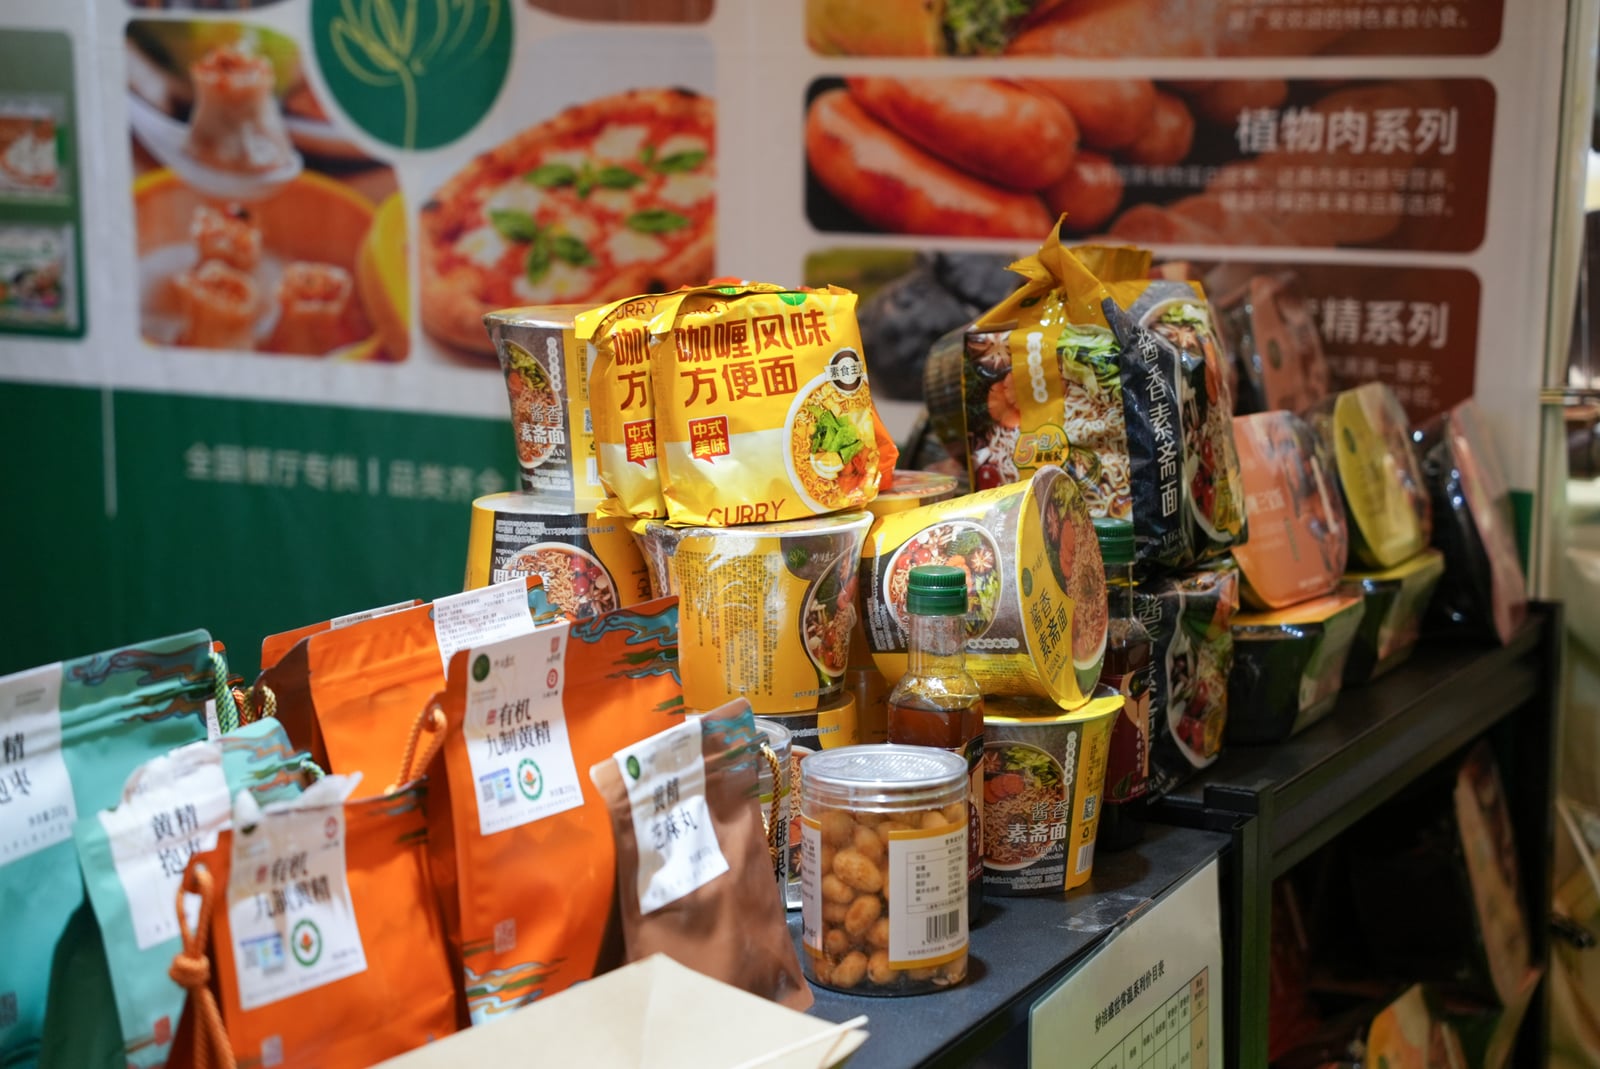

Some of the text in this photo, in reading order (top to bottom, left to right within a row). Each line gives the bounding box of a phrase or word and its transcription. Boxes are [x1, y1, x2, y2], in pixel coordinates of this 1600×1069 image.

[1235, 106, 1459, 155] 植物肉系列
[674, 309, 832, 363] 咖喱风味
[1312, 297, 1450, 348] 精系列
[612, 325, 650, 366] 咖
[684, 355, 799, 408] 方便面
[521, 422, 565, 445] 素斋面
[693, 419, 724, 437] 中式
[1135, 326, 1179, 518] 酱香素斋面
[695, 437, 727, 458] 美味
[707, 498, 786, 524] CURRY
[500, 699, 531, 727] 有机
[487, 720, 551, 759] 九制黄精
[153, 804, 199, 841] 黄精
[1032, 799, 1069, 821] 酱香
[1008, 820, 1068, 844] 素斋面
